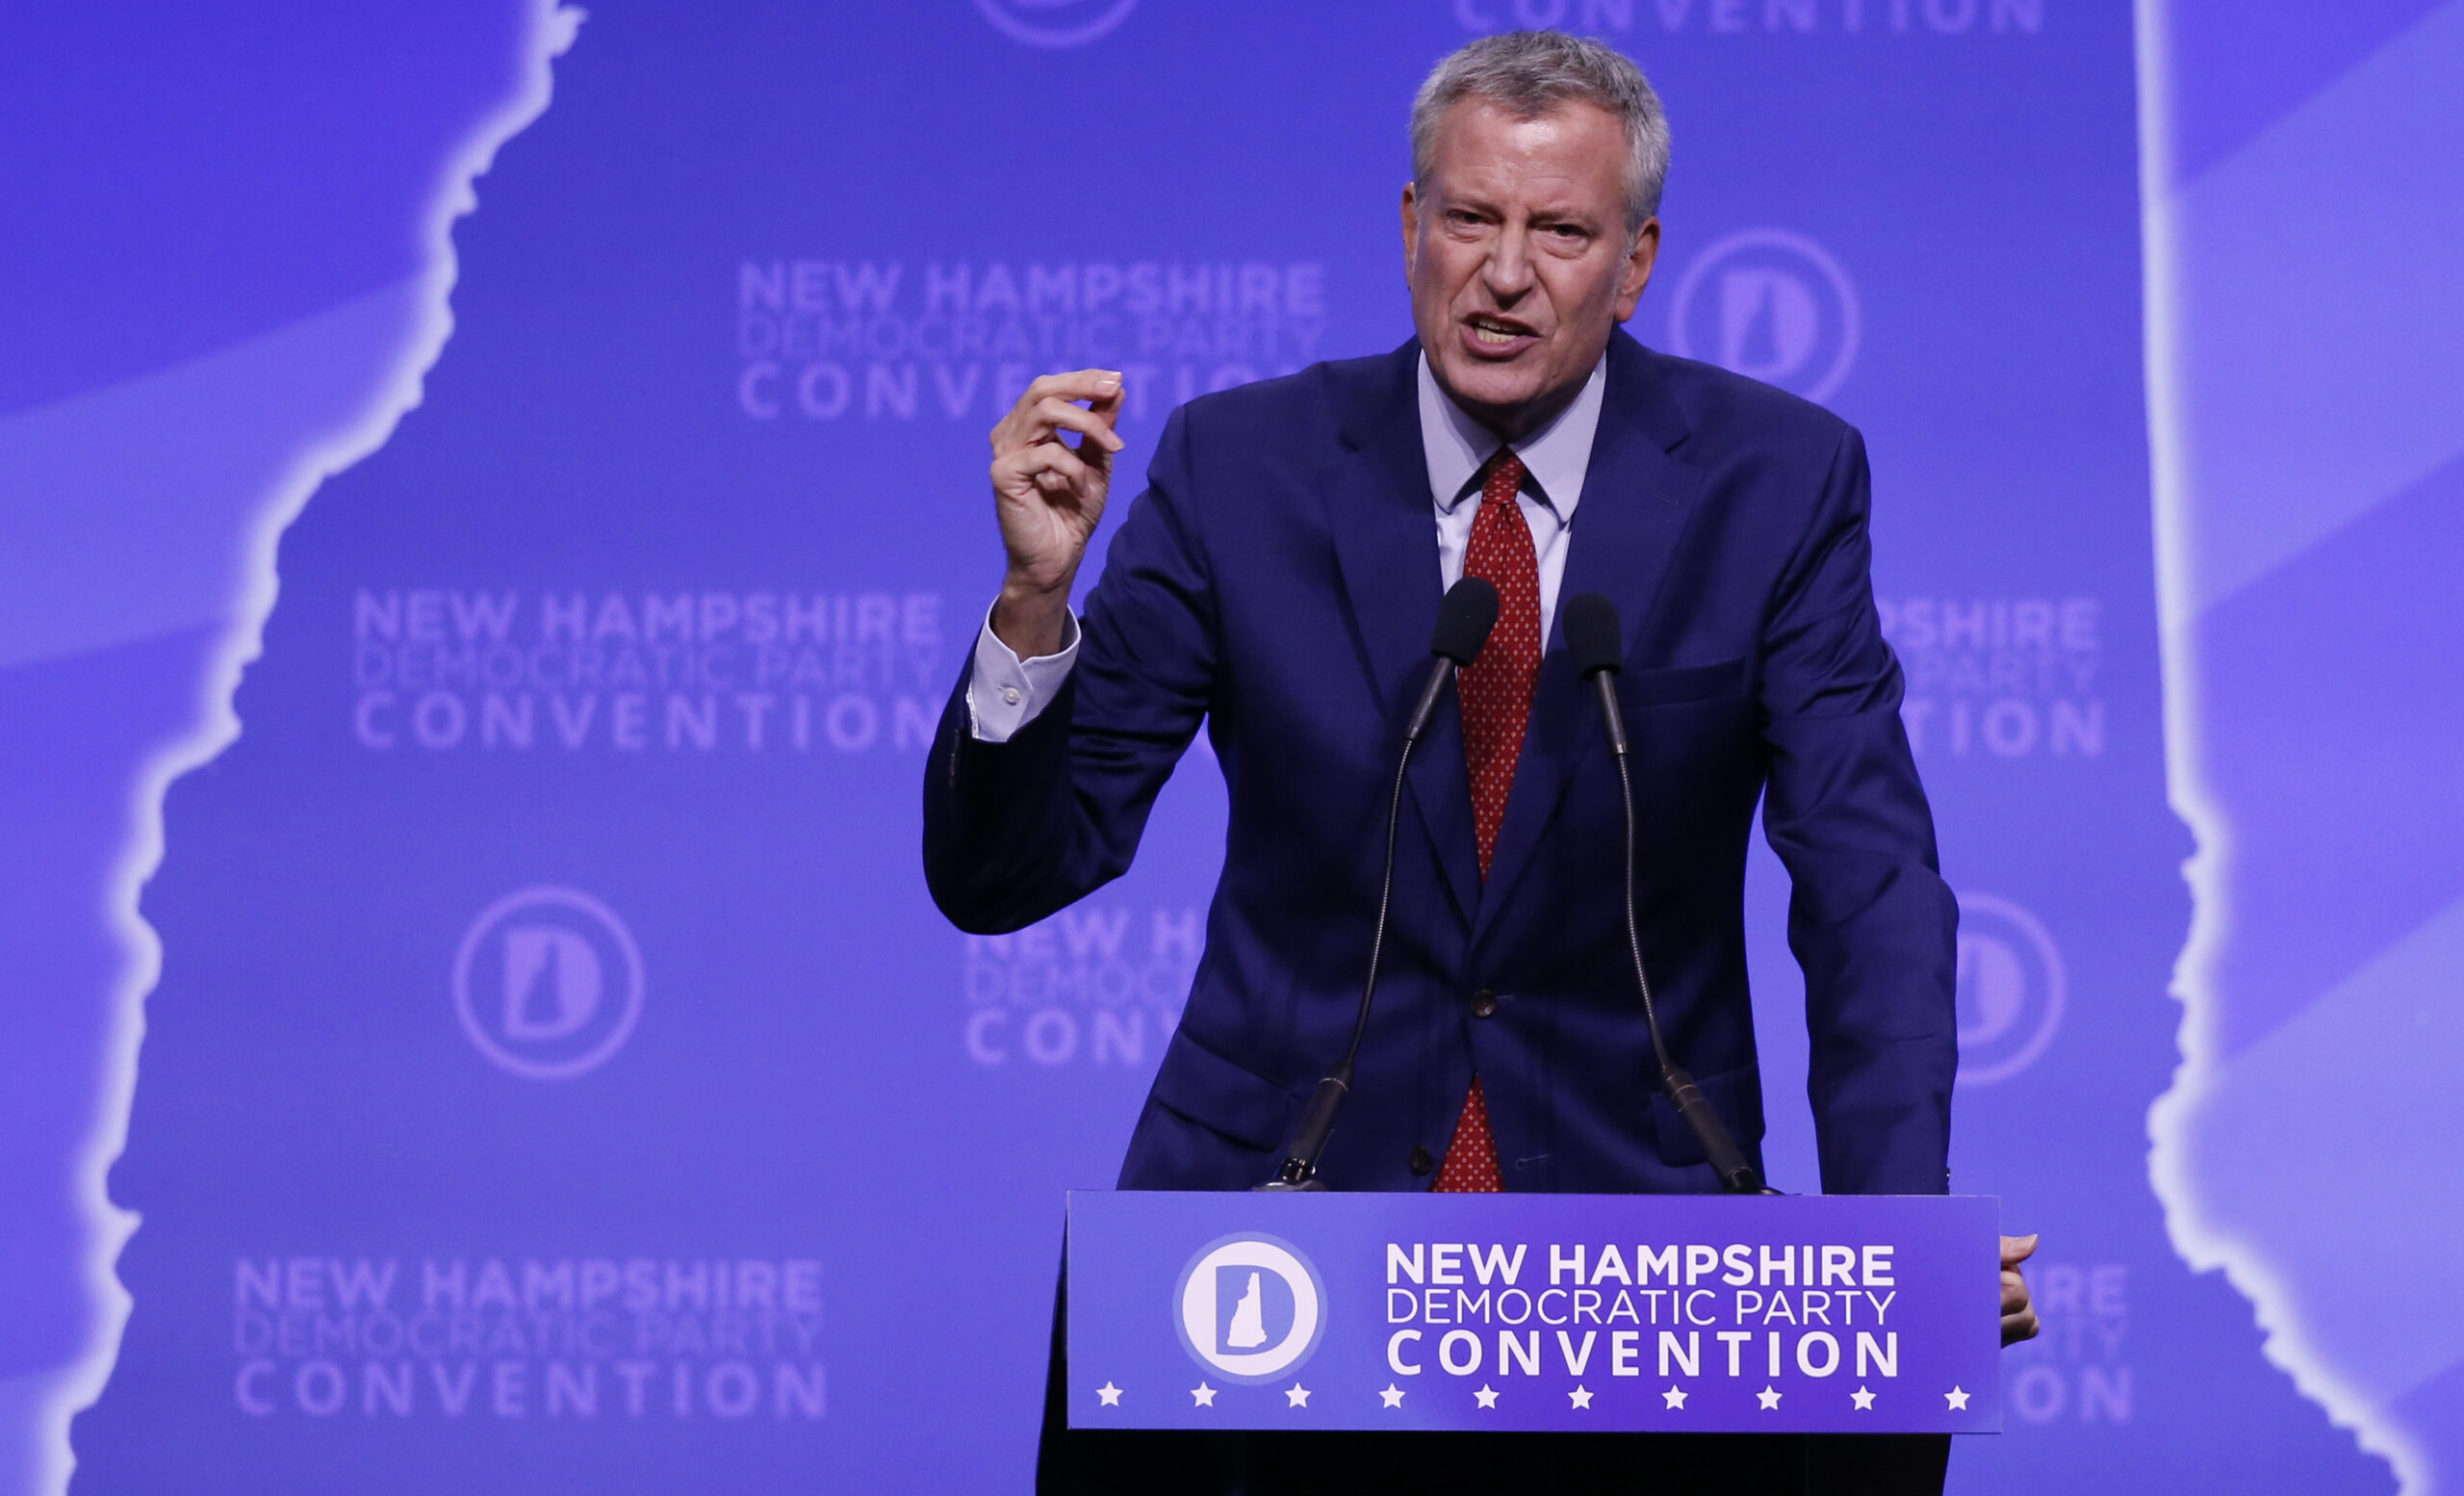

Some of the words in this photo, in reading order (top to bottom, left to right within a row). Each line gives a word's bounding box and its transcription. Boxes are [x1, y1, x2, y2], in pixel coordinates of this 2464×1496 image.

[739, 263, 900, 313] NEW
[926, 264, 1325, 315] HAMPSHIRE
[739, 315, 1122, 358] DEMOCRATIC
[1145, 316, 1327, 359] PARTY
[356, 591, 516, 640] NEW
[542, 592, 940, 643] HAMPSHIRE
[1878, 599, 2098, 650] SHIRE
[356, 646, 732, 686] DEMOCRATIC
[756, 648, 941, 688] PARTY
[356, 691, 948, 749] CONVENTION
[236, 1260, 398, 1309] NEW
[423, 1260, 824, 1311] HAMPSHIRE
[1388, 1244, 1527, 1284] NEW
[1551, 1245, 1894, 1285] HAMPSHIRE
[1388, 1289, 1715, 1325] DEMOCRATIC
[1737, 1291, 1896, 1325] PARTY
[236, 1313, 614, 1354] DEMOCRATIC
[636, 1315, 824, 1355] PARTY
[1388, 1329, 1897, 1377] CONVENTION
[235, 1360, 827, 1418] CONVENTION
